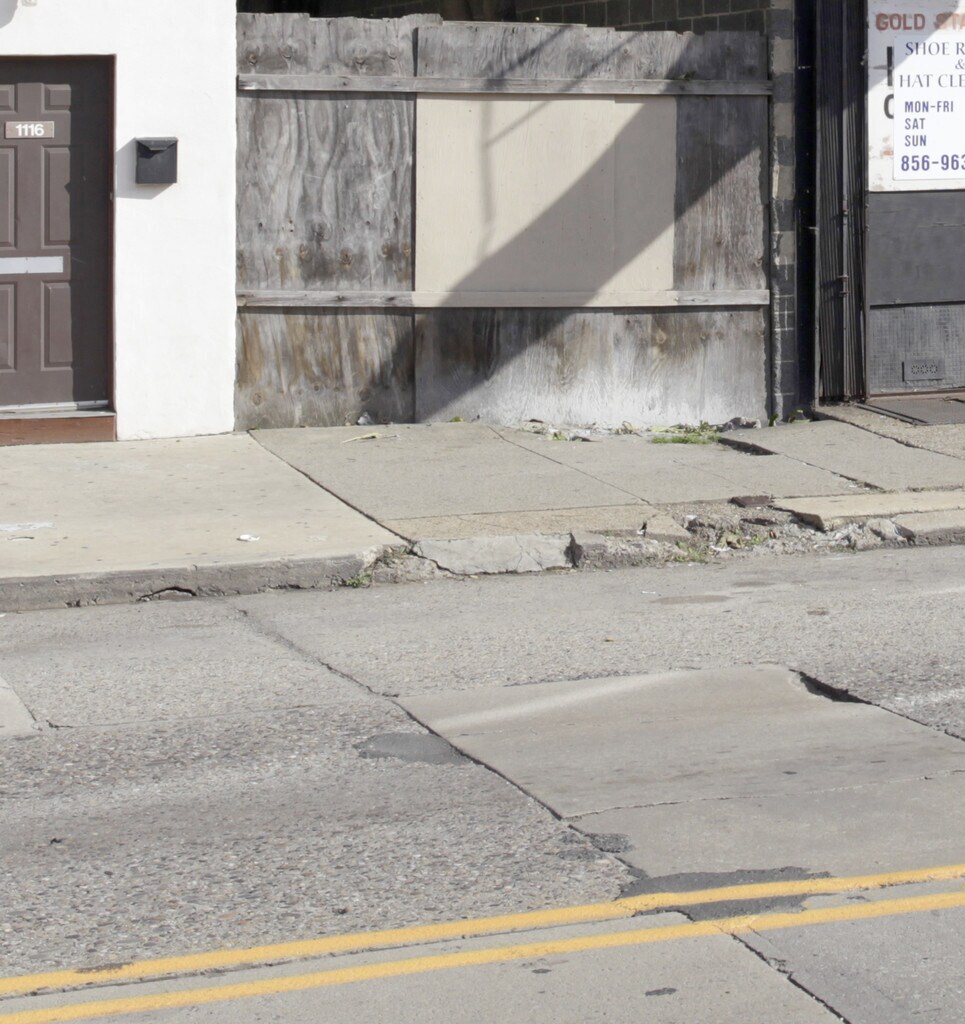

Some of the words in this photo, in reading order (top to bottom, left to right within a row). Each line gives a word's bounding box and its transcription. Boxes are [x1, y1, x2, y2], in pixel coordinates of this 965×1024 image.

[875, 12, 926, 31] GOLD
[905, 41, 950, 56] SHOE
[955, 58, 965, 70] &
[899, 74, 933, 88] HAT
[904, 100, 954, 113] MON-FRI
[15, 123, 44, 136] 1116
[904, 117, 926, 130] SAT
[904, 134, 927, 147] SUN
